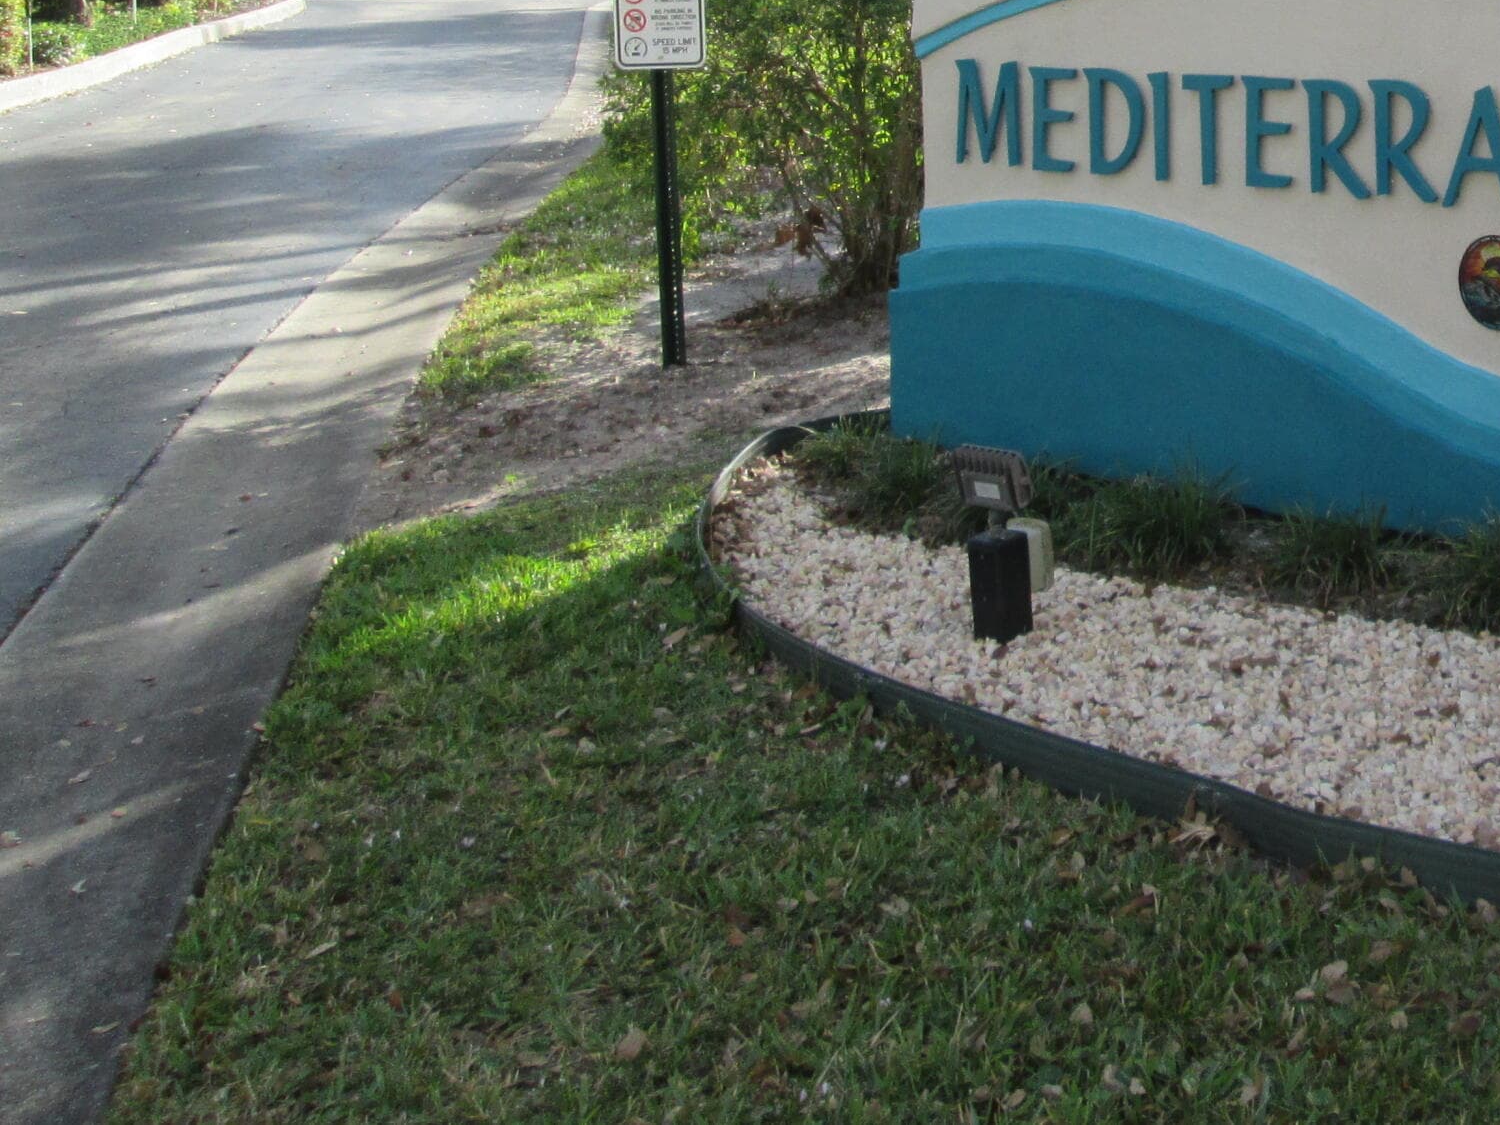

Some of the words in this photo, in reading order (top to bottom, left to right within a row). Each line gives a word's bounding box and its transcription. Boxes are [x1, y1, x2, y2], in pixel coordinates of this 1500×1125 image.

[652, 38, 676, 46] SPEED
[677, 37, 697, 45] LIMIT
[671, 46, 688, 54] MPH
